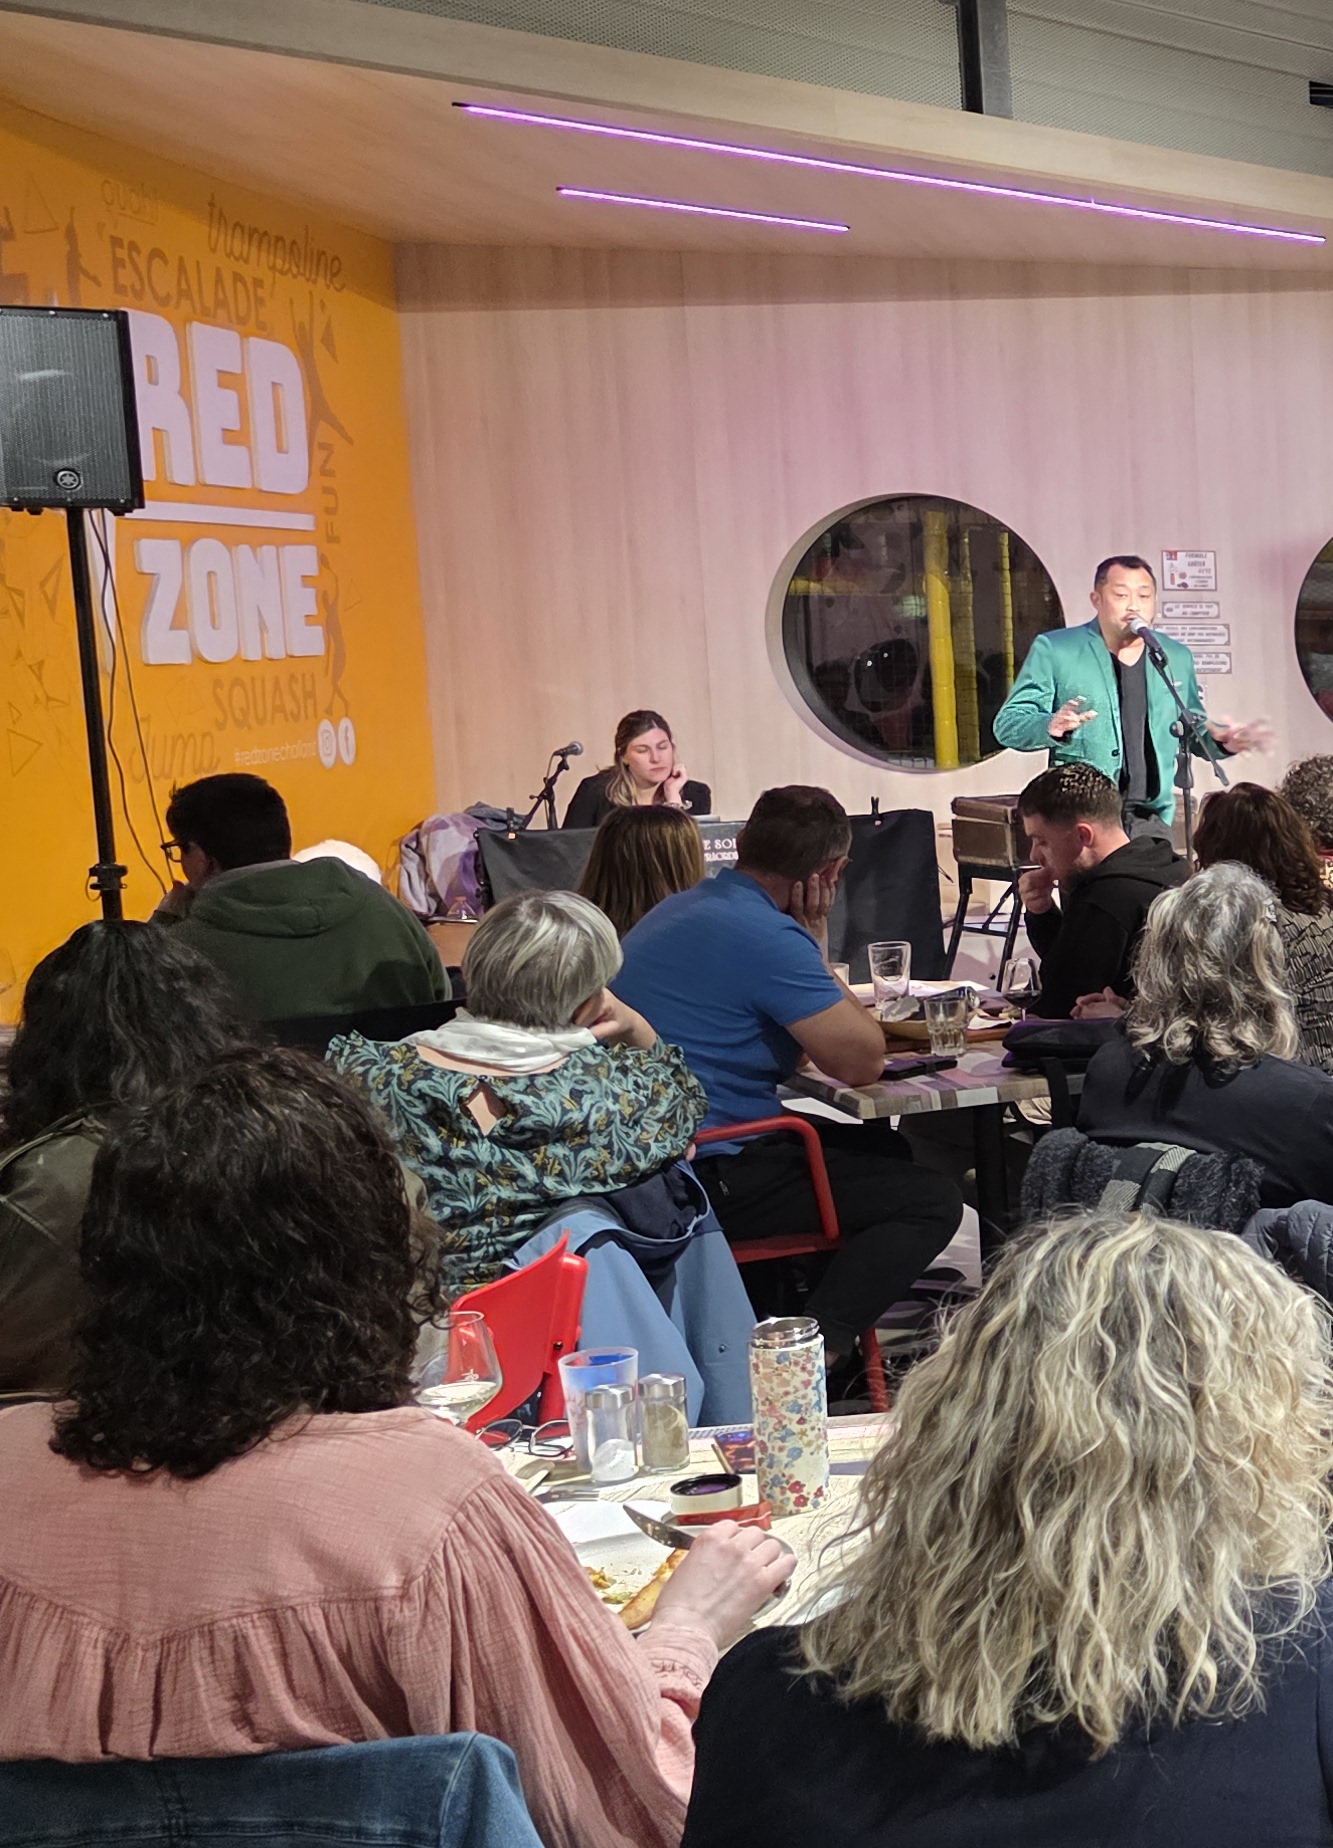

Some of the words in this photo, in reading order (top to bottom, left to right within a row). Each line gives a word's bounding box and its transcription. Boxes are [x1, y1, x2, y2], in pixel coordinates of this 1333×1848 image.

[109, 235, 267, 332] ESCALADE
[208, 192, 347, 297] trampoline
[126, 308, 310, 494] RED
[318, 442, 341, 544] FUN
[133, 538, 326, 665] ZONE
[212, 672, 318, 731] SQUASH
